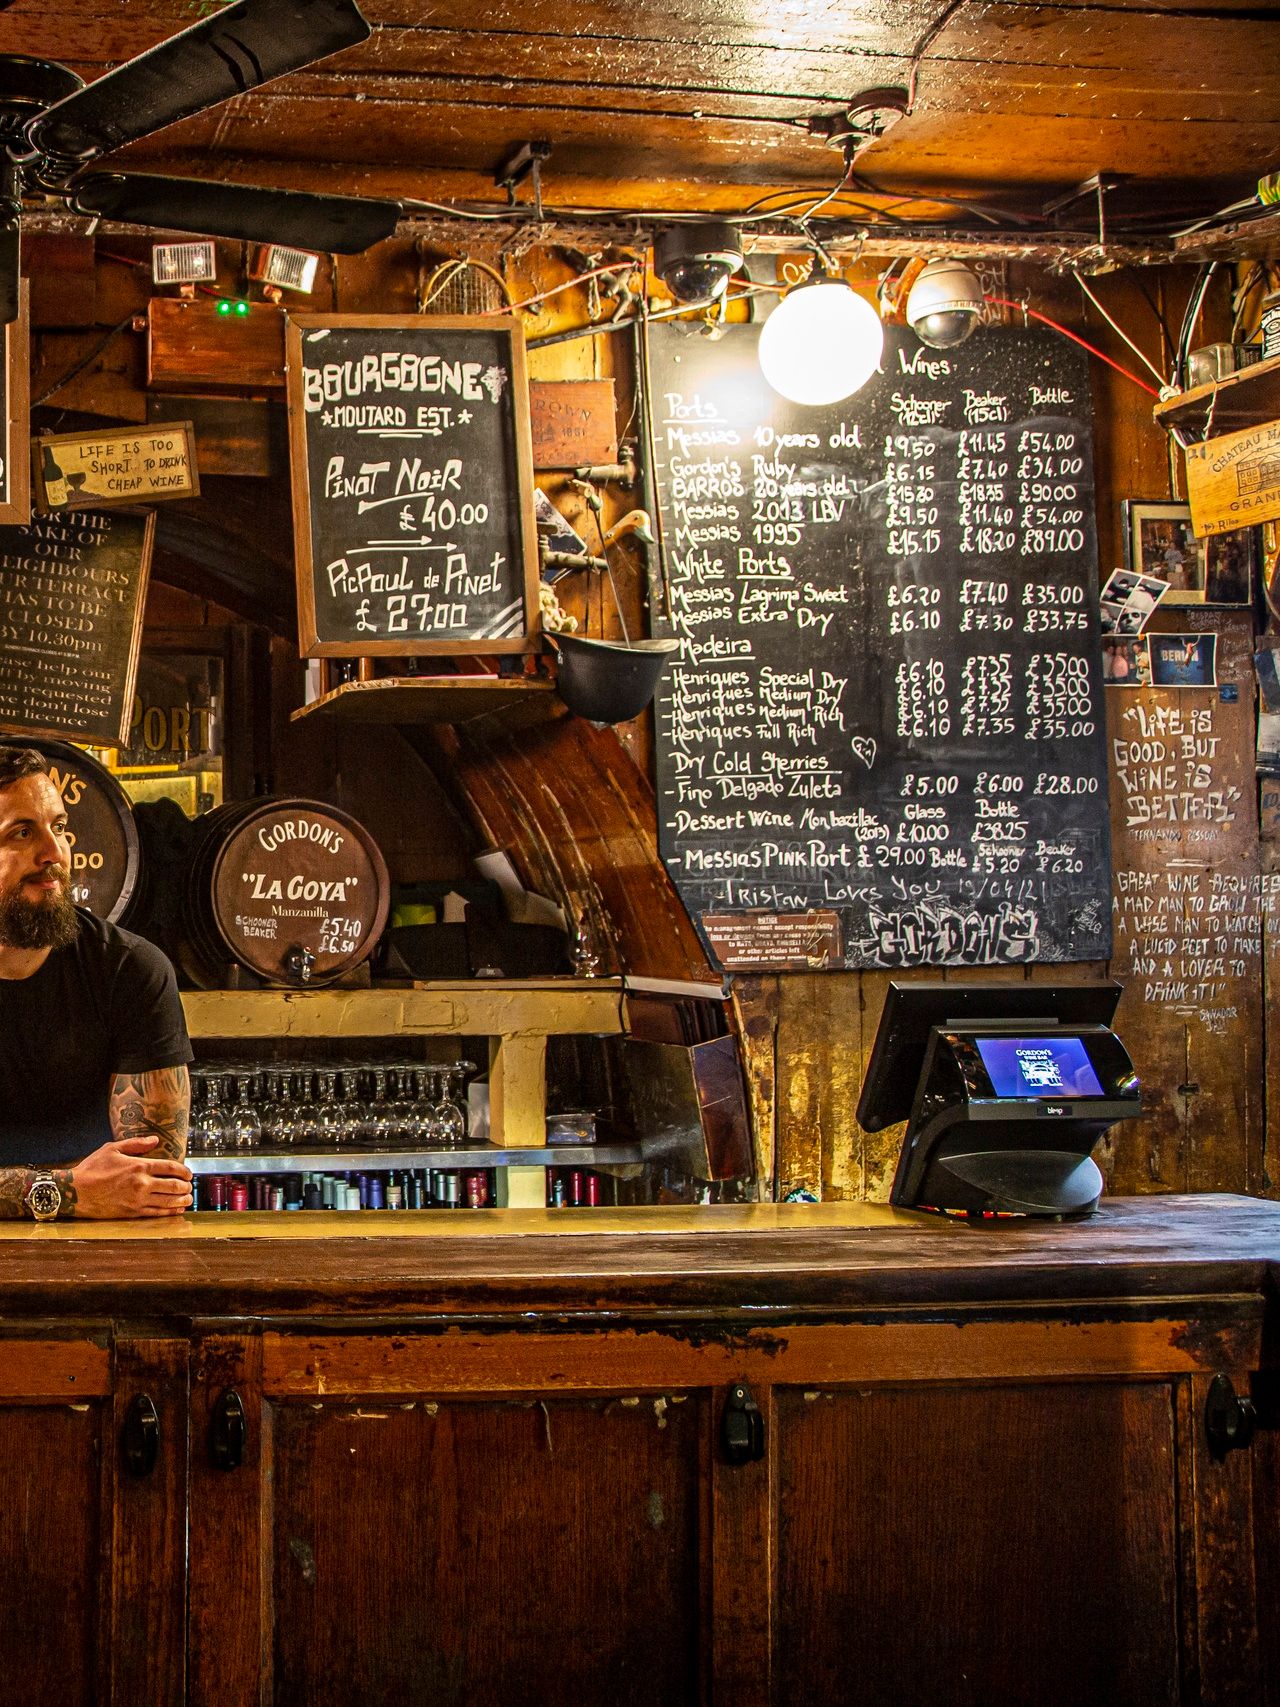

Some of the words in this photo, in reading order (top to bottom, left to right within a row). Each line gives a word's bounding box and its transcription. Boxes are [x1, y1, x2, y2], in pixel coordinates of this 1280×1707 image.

[898, 347, 951, 380] Wines
[302, 352, 484, 412] BOURGOGNE
[890, 392, 952, 413] Schooner
[1029, 385, 1074, 405] Bottle
[331, 405, 407, 427] MOUTARD
[417, 406, 455, 427] EST.
[79, 445, 114, 459] LIFE
[123, 441, 140, 454] IS
[149, 439, 174, 452] TOO
[829, 422, 863, 449] old
[957, 430, 1007, 458] £11.45
[1018, 430, 1075, 453] £54.00
[144, 459, 156, 471] TO
[159, 454, 188, 468] DRINK
[1212, 433, 1261, 473] CHATEAU
[750, 454, 796, 485] Ruby
[884, 462, 936, 483] £6.15
[956, 456, 1009, 481] £7.40
[1017, 455, 1084, 480] £34.00
[107, 478, 142, 492] CHEAP
[149, 475, 185, 487] WINE
[671, 475, 745, 502] BARROS
[70, 512, 112, 531] THE
[673, 500, 740, 525] Messias
[811, 499, 847, 523] LBV
[1020, 504, 1084, 529] £54.00
[78, 531, 108, 546] OF
[752, 522, 807, 546] 1995
[1020, 528, 1085, 556] £89.00
[35, 542, 82, 561] OUR
[671, 546, 727, 584] White
[737, 547, 791, 577] Ports
[33, 577, 129, 602] TERRACE
[423, 566, 441, 589] de
[803, 582, 849, 603] Sweet
[1022, 583, 1085, 606] £35.00
[8, 608, 95, 632] CLOSED
[738, 607, 789, 625] Extra
[797, 607, 834, 637] Dry
[1022, 609, 1089, 633] £33.75
[28, 629, 104, 652] 10.30pm
[679, 633, 753, 666] Madeira
[37, 660, 78, 676] help
[759, 666, 814, 691] Special
[23, 686, 112, 705] requested
[44, 676, 113, 694] moving
[23, 697, 69, 711] don't
[74, 703, 109, 718] lose
[25, 709, 88, 727] licence
[755, 723, 781, 740] Full
[787, 722, 818, 747] Rich
[961, 714, 1015, 737] £7.35
[1024, 718, 1095, 741] £35.00
[1181, 735, 1221, 760] BUT
[713, 750, 752, 776] Cold
[900, 774, 959, 797] £5.00
[973, 772, 1024, 795] £6.00
[1033, 772, 1098, 796] £28.00
[677, 781, 713, 809] Fino
[716, 777, 784, 801] Delgado
[788, 774, 842, 799] Zuleta
[904, 804, 946, 820] Glass
[974, 799, 1020, 819] Bottle
[675, 809, 746, 837] Dessert
[748, 809, 795, 830] Wine
[258, 820, 346, 854] GORDON'S
[807, 840, 852, 868] Port
[930, 848, 968, 869] Bottle
[1117, 871, 1160, 893] GREAT
[271, 904, 329, 918] Manzanilla
[1124, 896, 1155, 913] MAD
[1158, 896, 1185, 914] MAN
[235, 914, 278, 930] SCHOONER
[320, 917, 362, 938] £5.40
[243, 926, 277, 940] BEAKER
[1181, 957, 1226, 978] LOVER
